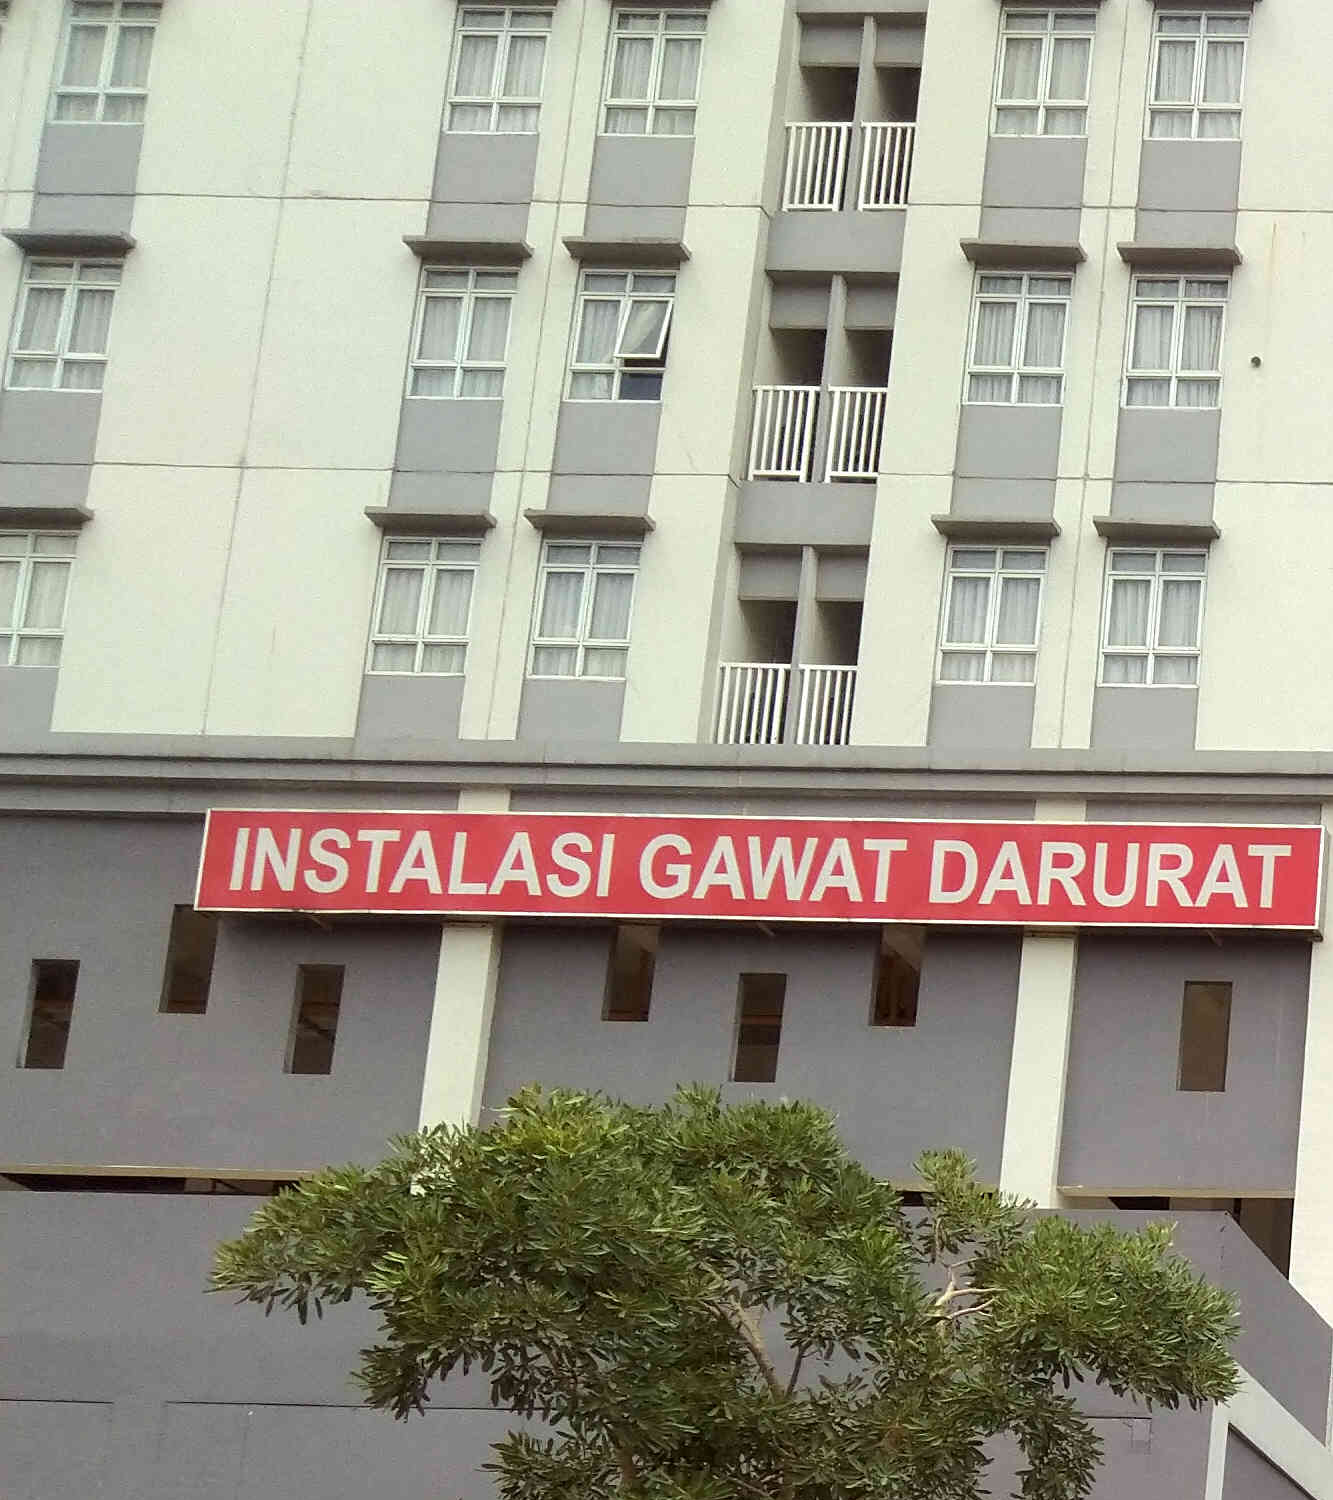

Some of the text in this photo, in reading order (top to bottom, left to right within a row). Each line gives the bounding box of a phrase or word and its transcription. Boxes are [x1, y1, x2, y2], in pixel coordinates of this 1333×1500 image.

[229, 827, 1292, 910] INSTALASI GAWAT DARURAT
